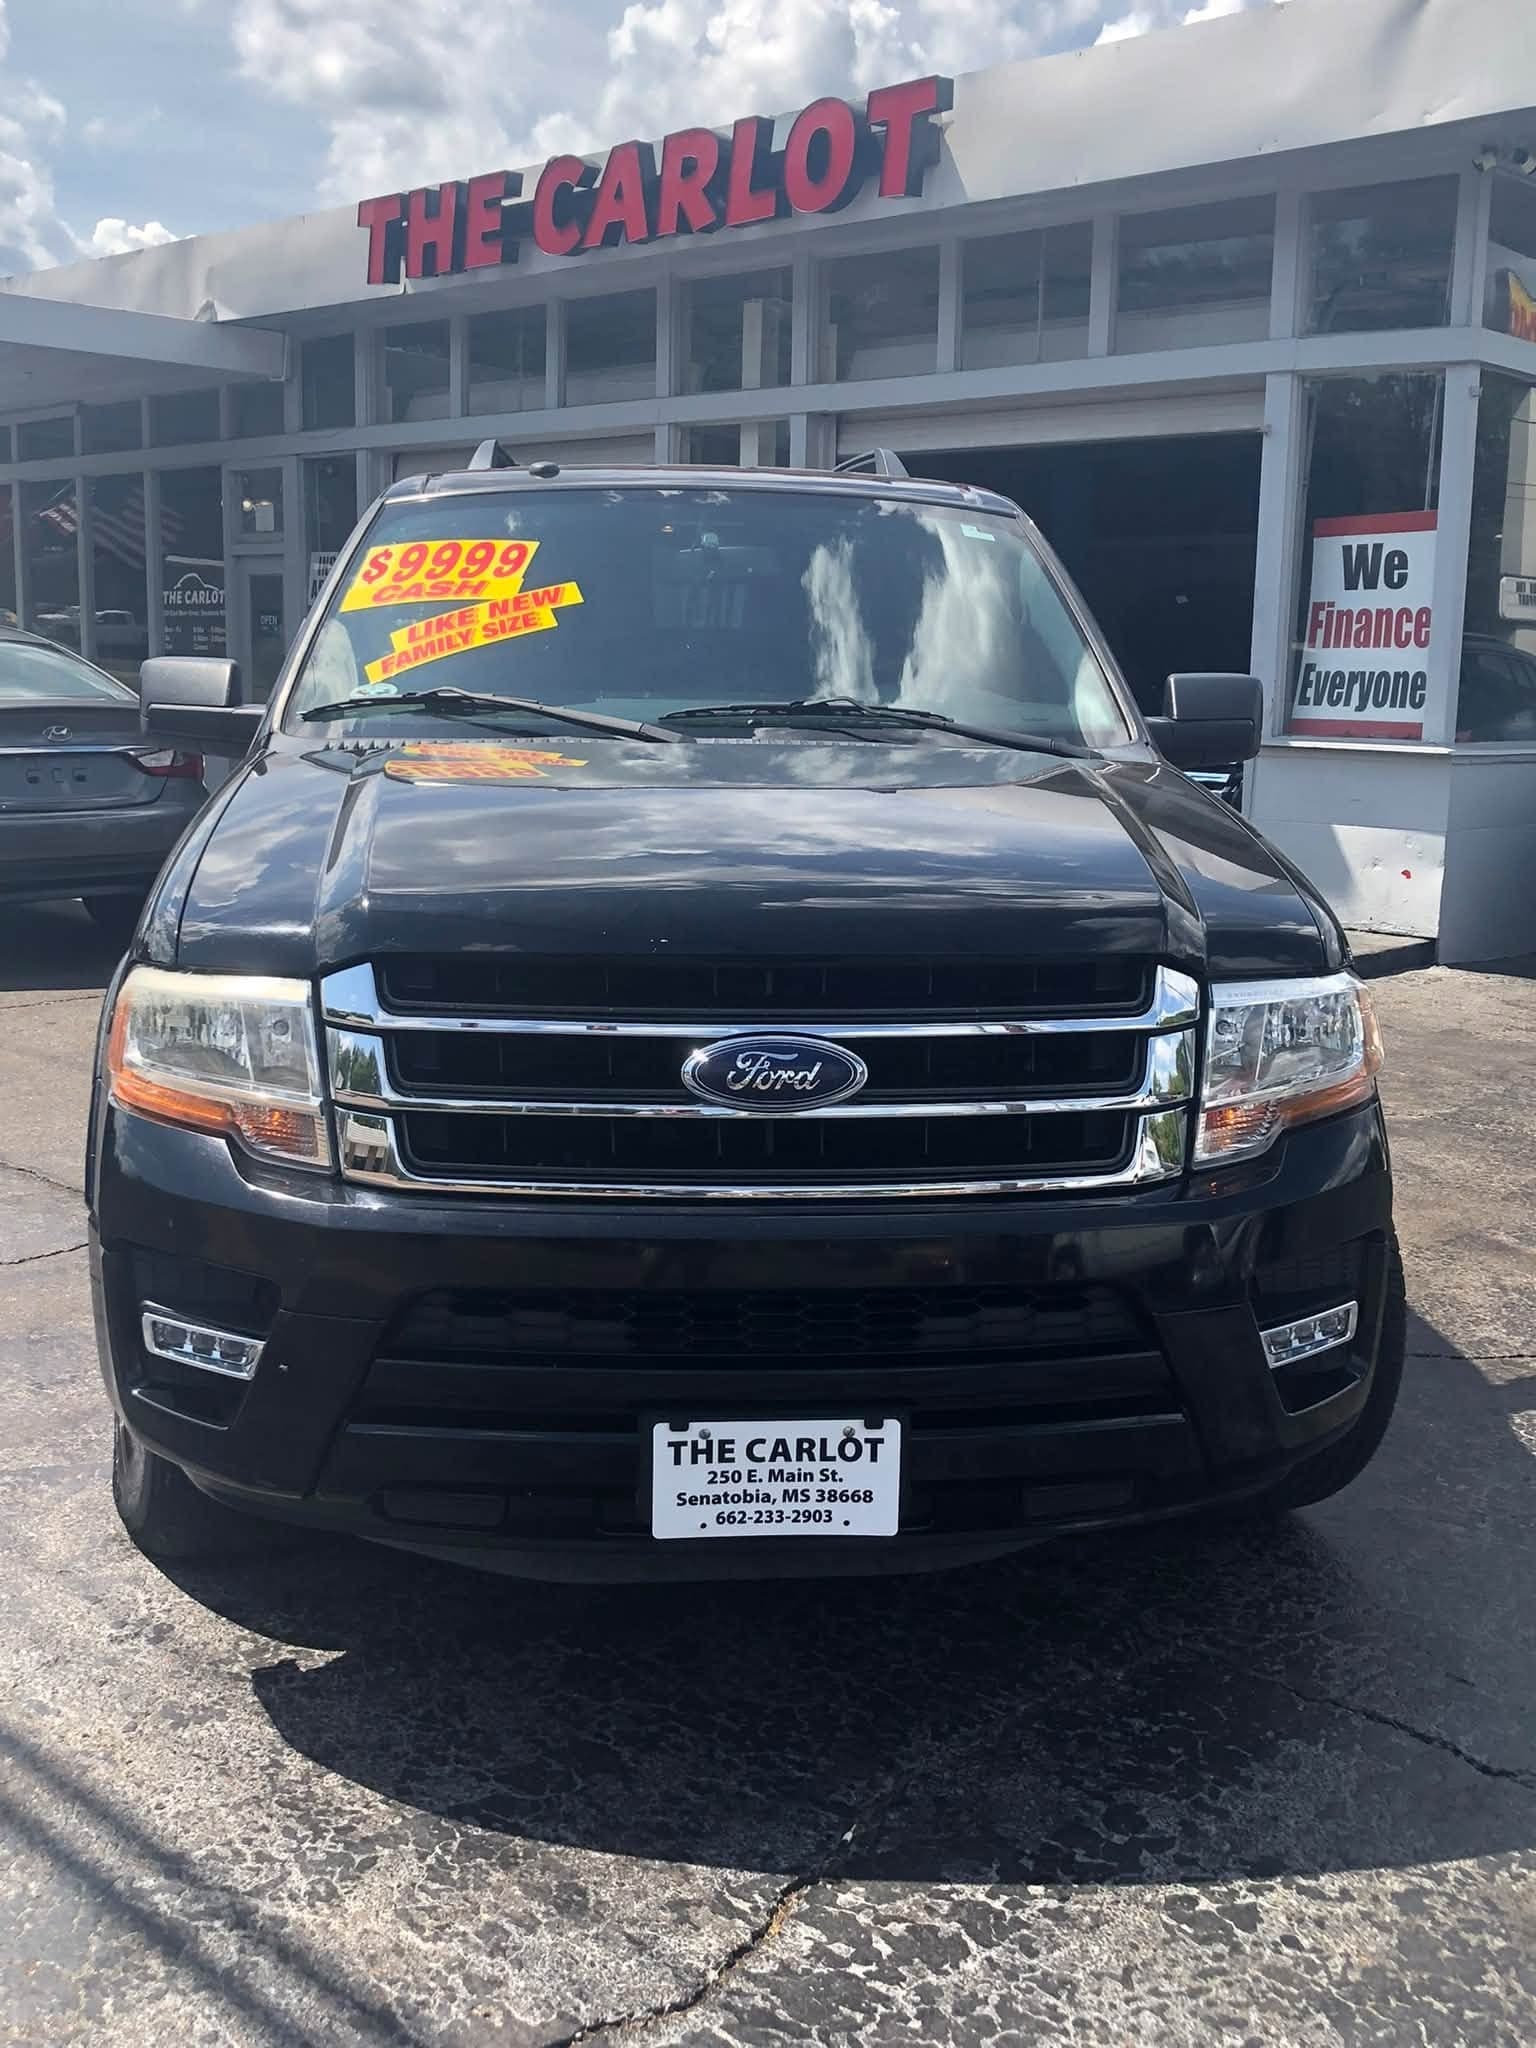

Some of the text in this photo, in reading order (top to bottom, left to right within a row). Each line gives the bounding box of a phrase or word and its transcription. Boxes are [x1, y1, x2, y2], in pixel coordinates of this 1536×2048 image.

[358, 75, 954, 285] THE CARLOT
[361, 541, 530, 584] $9999
[1341, 542, 1409, 591] We
[163, 590, 225, 605] THE CARLOT
[371, 580, 491, 603] CASH
[260, 615, 278, 625] OPEN
[405, 586, 565, 645] LIKE NEW
[1307, 601, 1432, 649] Finance
[380, 612, 544, 676] FAMILY SIZE
[1298, 663, 1427, 713] Everyone
[726, 1051, 823, 1091] Ford
[667, 1437, 885, 1466] THE CARLOT
[706, 1468, 844, 1485] 250 E. Main St.
[676, 1488, 874, 1506] Senatobia, MS 38668
[715, 1509, 833, 1525] 662-233-2903
